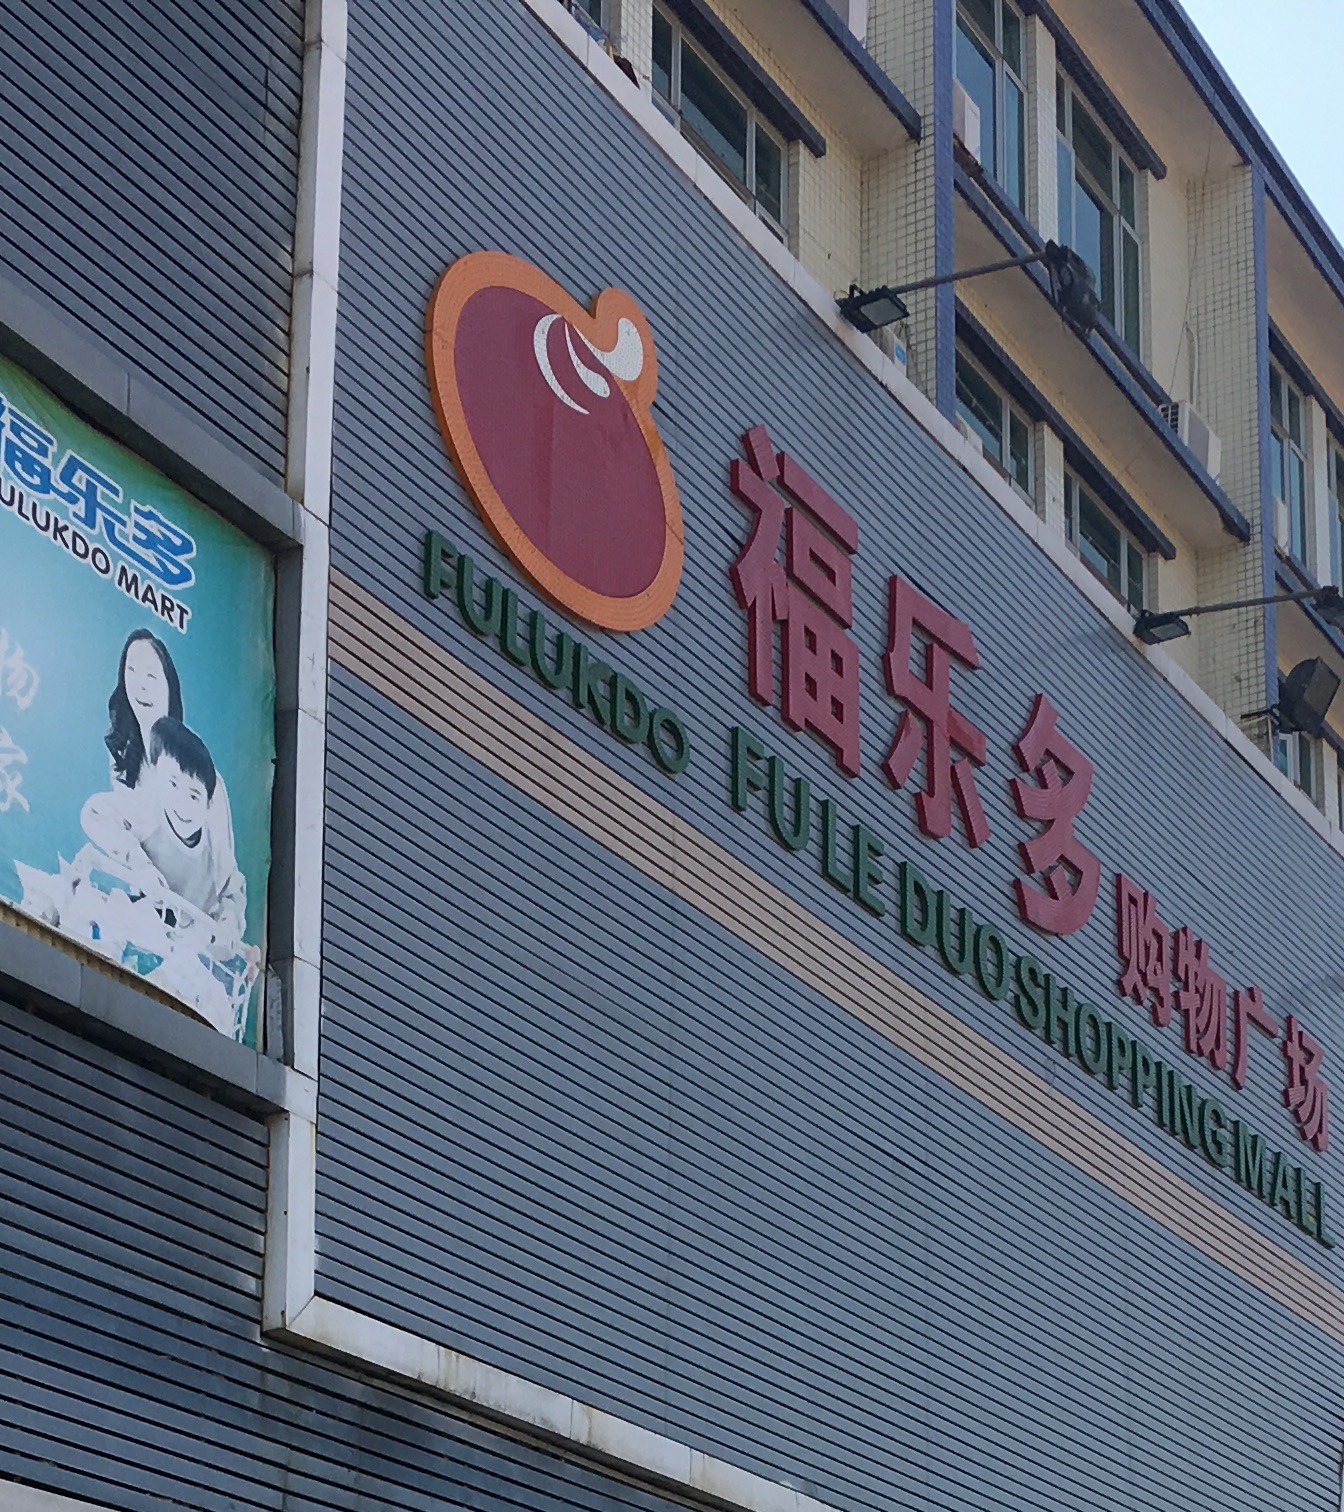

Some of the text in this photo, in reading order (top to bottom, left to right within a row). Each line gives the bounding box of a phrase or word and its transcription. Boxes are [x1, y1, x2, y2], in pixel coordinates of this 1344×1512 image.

[116, 562, 191, 634] MART
[424, 530, 691, 774] FULUKDO
[730, 424, 1330, 1152] 福乐多 购物广场
